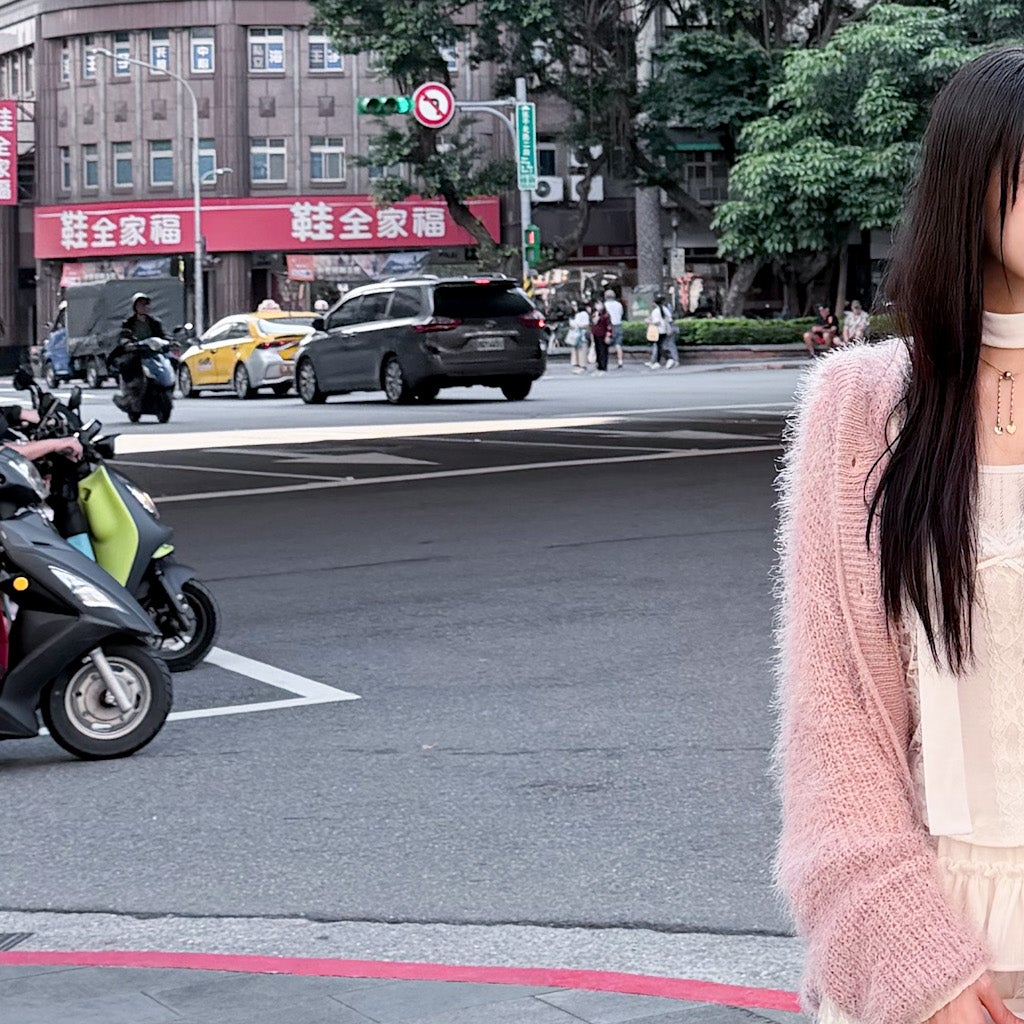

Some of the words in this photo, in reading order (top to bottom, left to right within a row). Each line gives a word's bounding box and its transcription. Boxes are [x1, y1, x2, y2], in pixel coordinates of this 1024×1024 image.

[60, 210, 181, 249] 鞋全家福
[290, 201, 446, 242] 鞋全家福
